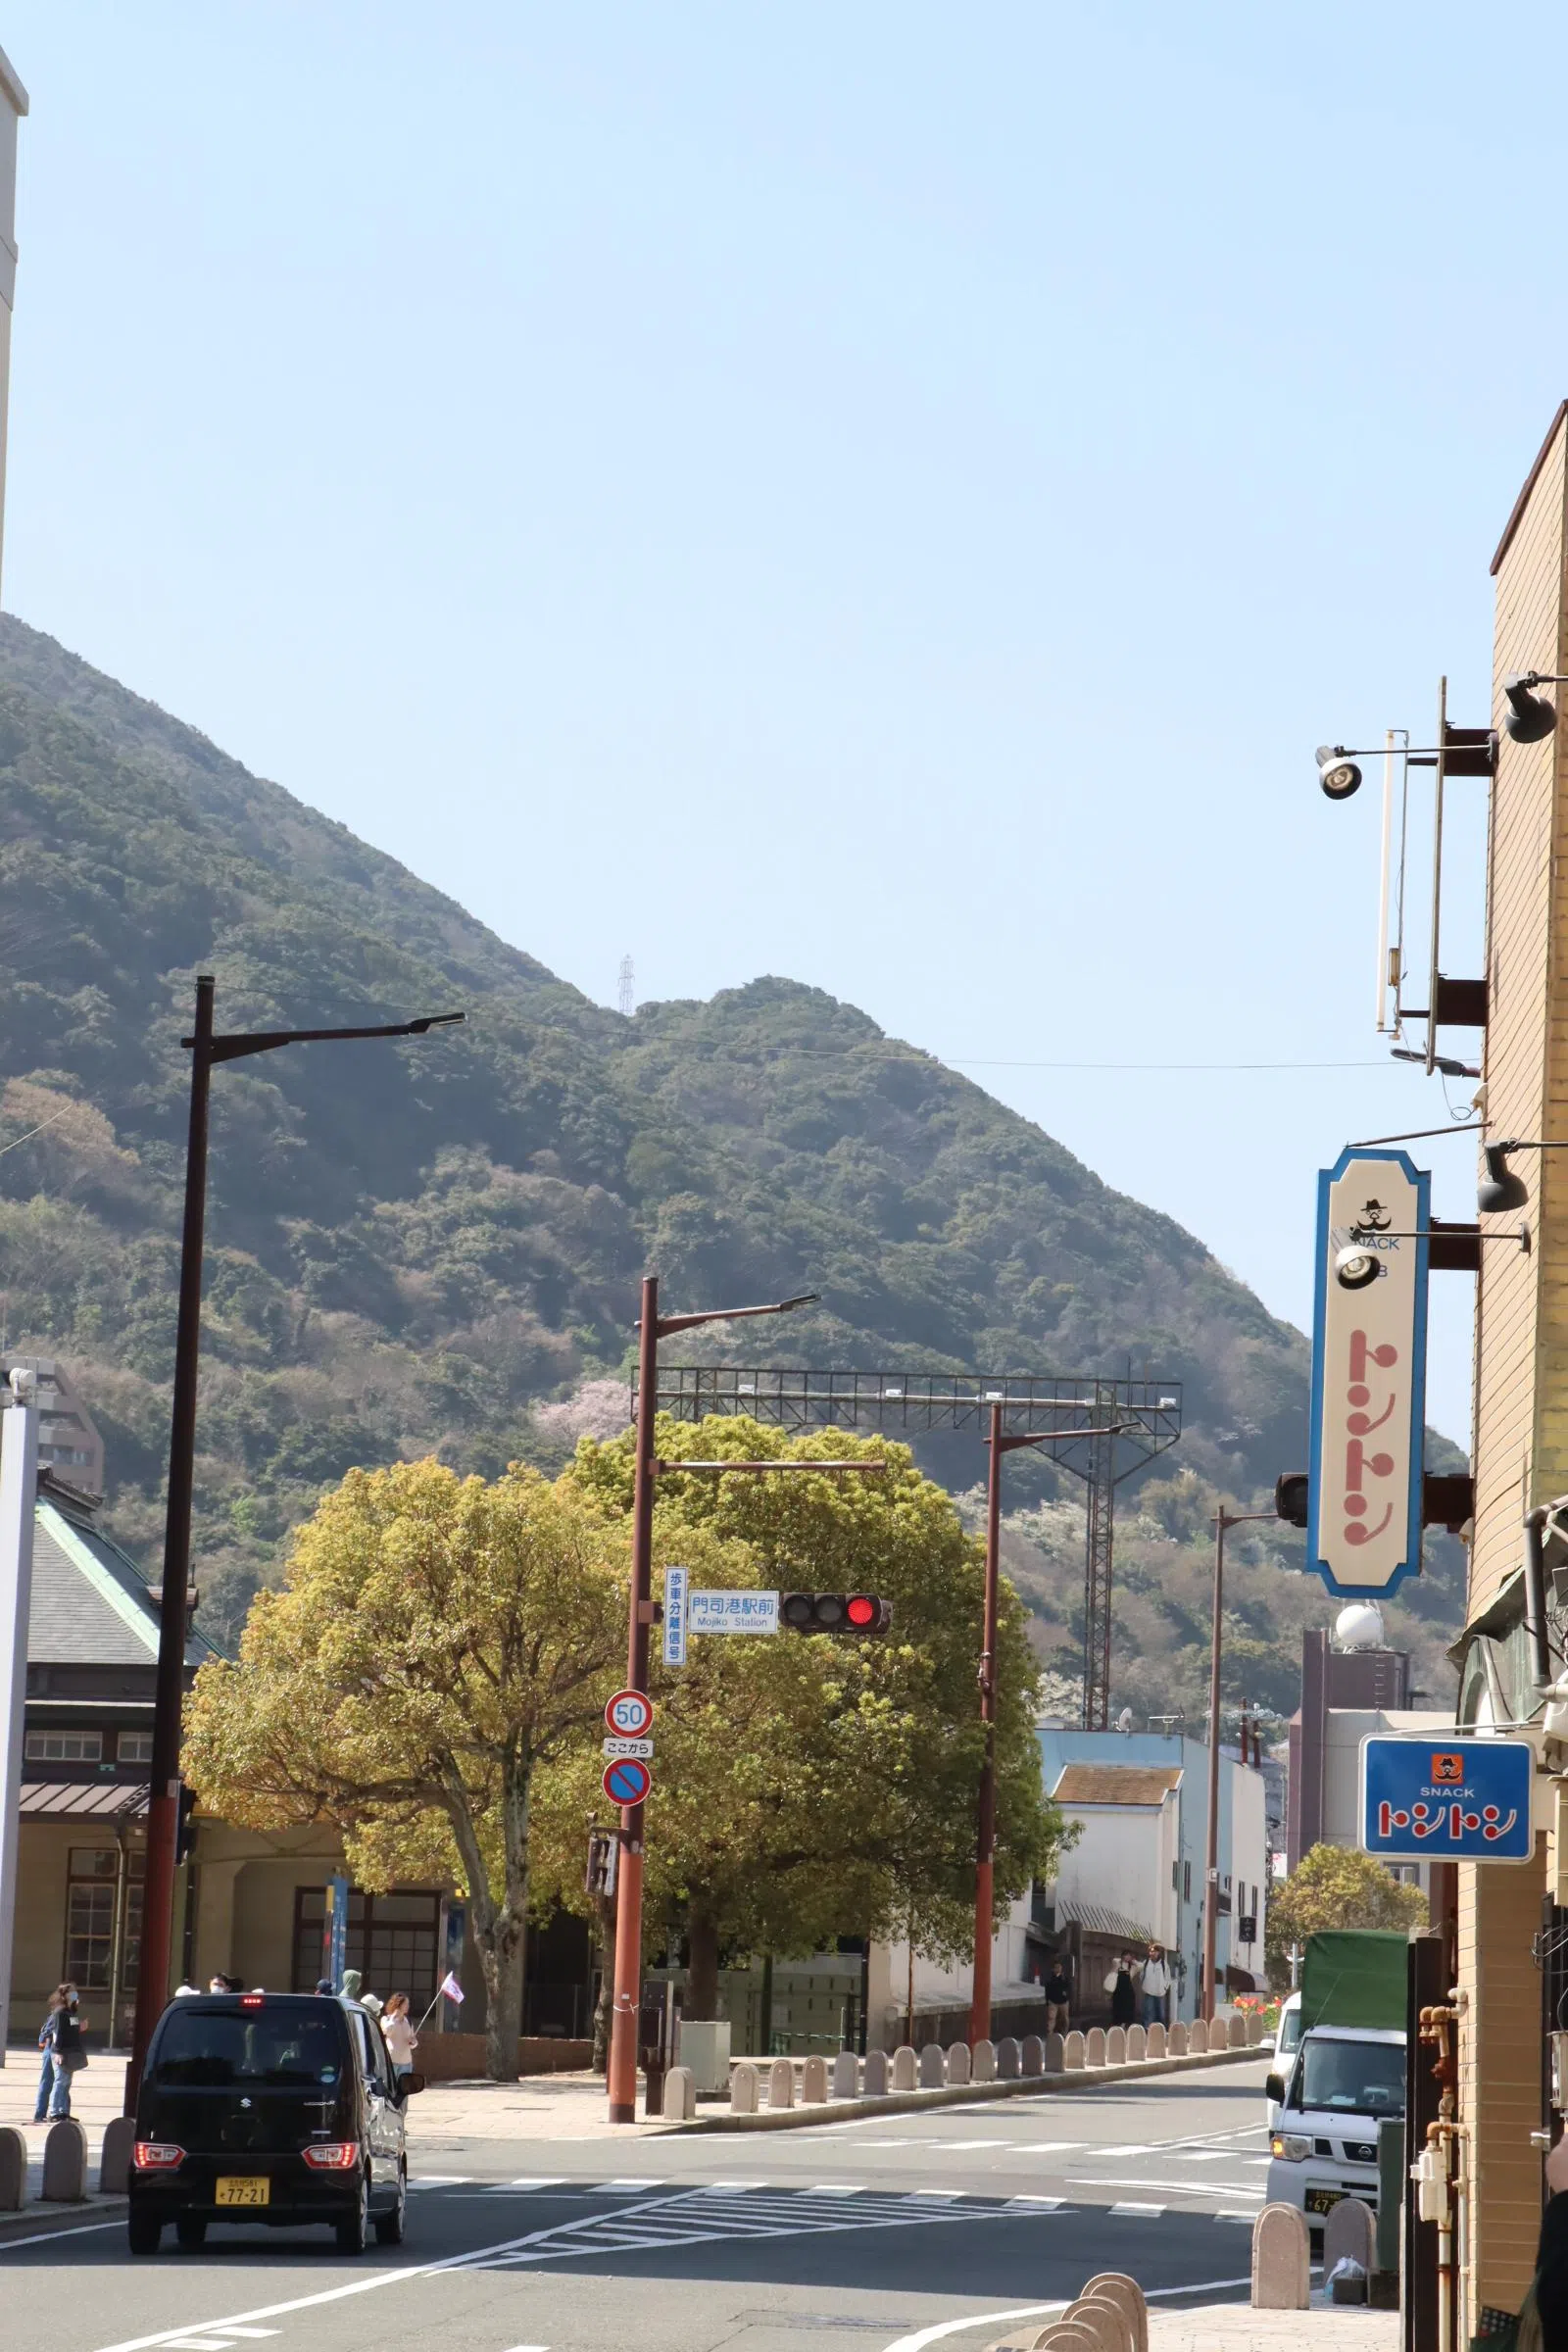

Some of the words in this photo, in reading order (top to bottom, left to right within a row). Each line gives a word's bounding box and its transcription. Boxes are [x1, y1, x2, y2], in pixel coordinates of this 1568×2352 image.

[1351, 1237, 1400, 1250] NACK
[1343, 1329, 1398, 1546] トントン
[692, 1596, 774, 1615] 門司港駅前
[668, 1572, 683, 1659] 歩車分離信号
[697, 1617, 728, 1628] Mojiko
[734, 1617, 767, 1627] Station
[616, 1704, 643, 1725] 50
[608, 1742, 649, 1754] ここから
[1419, 1787, 1475, 1798] SNACK
[1378, 1800, 1517, 1841] トントン
